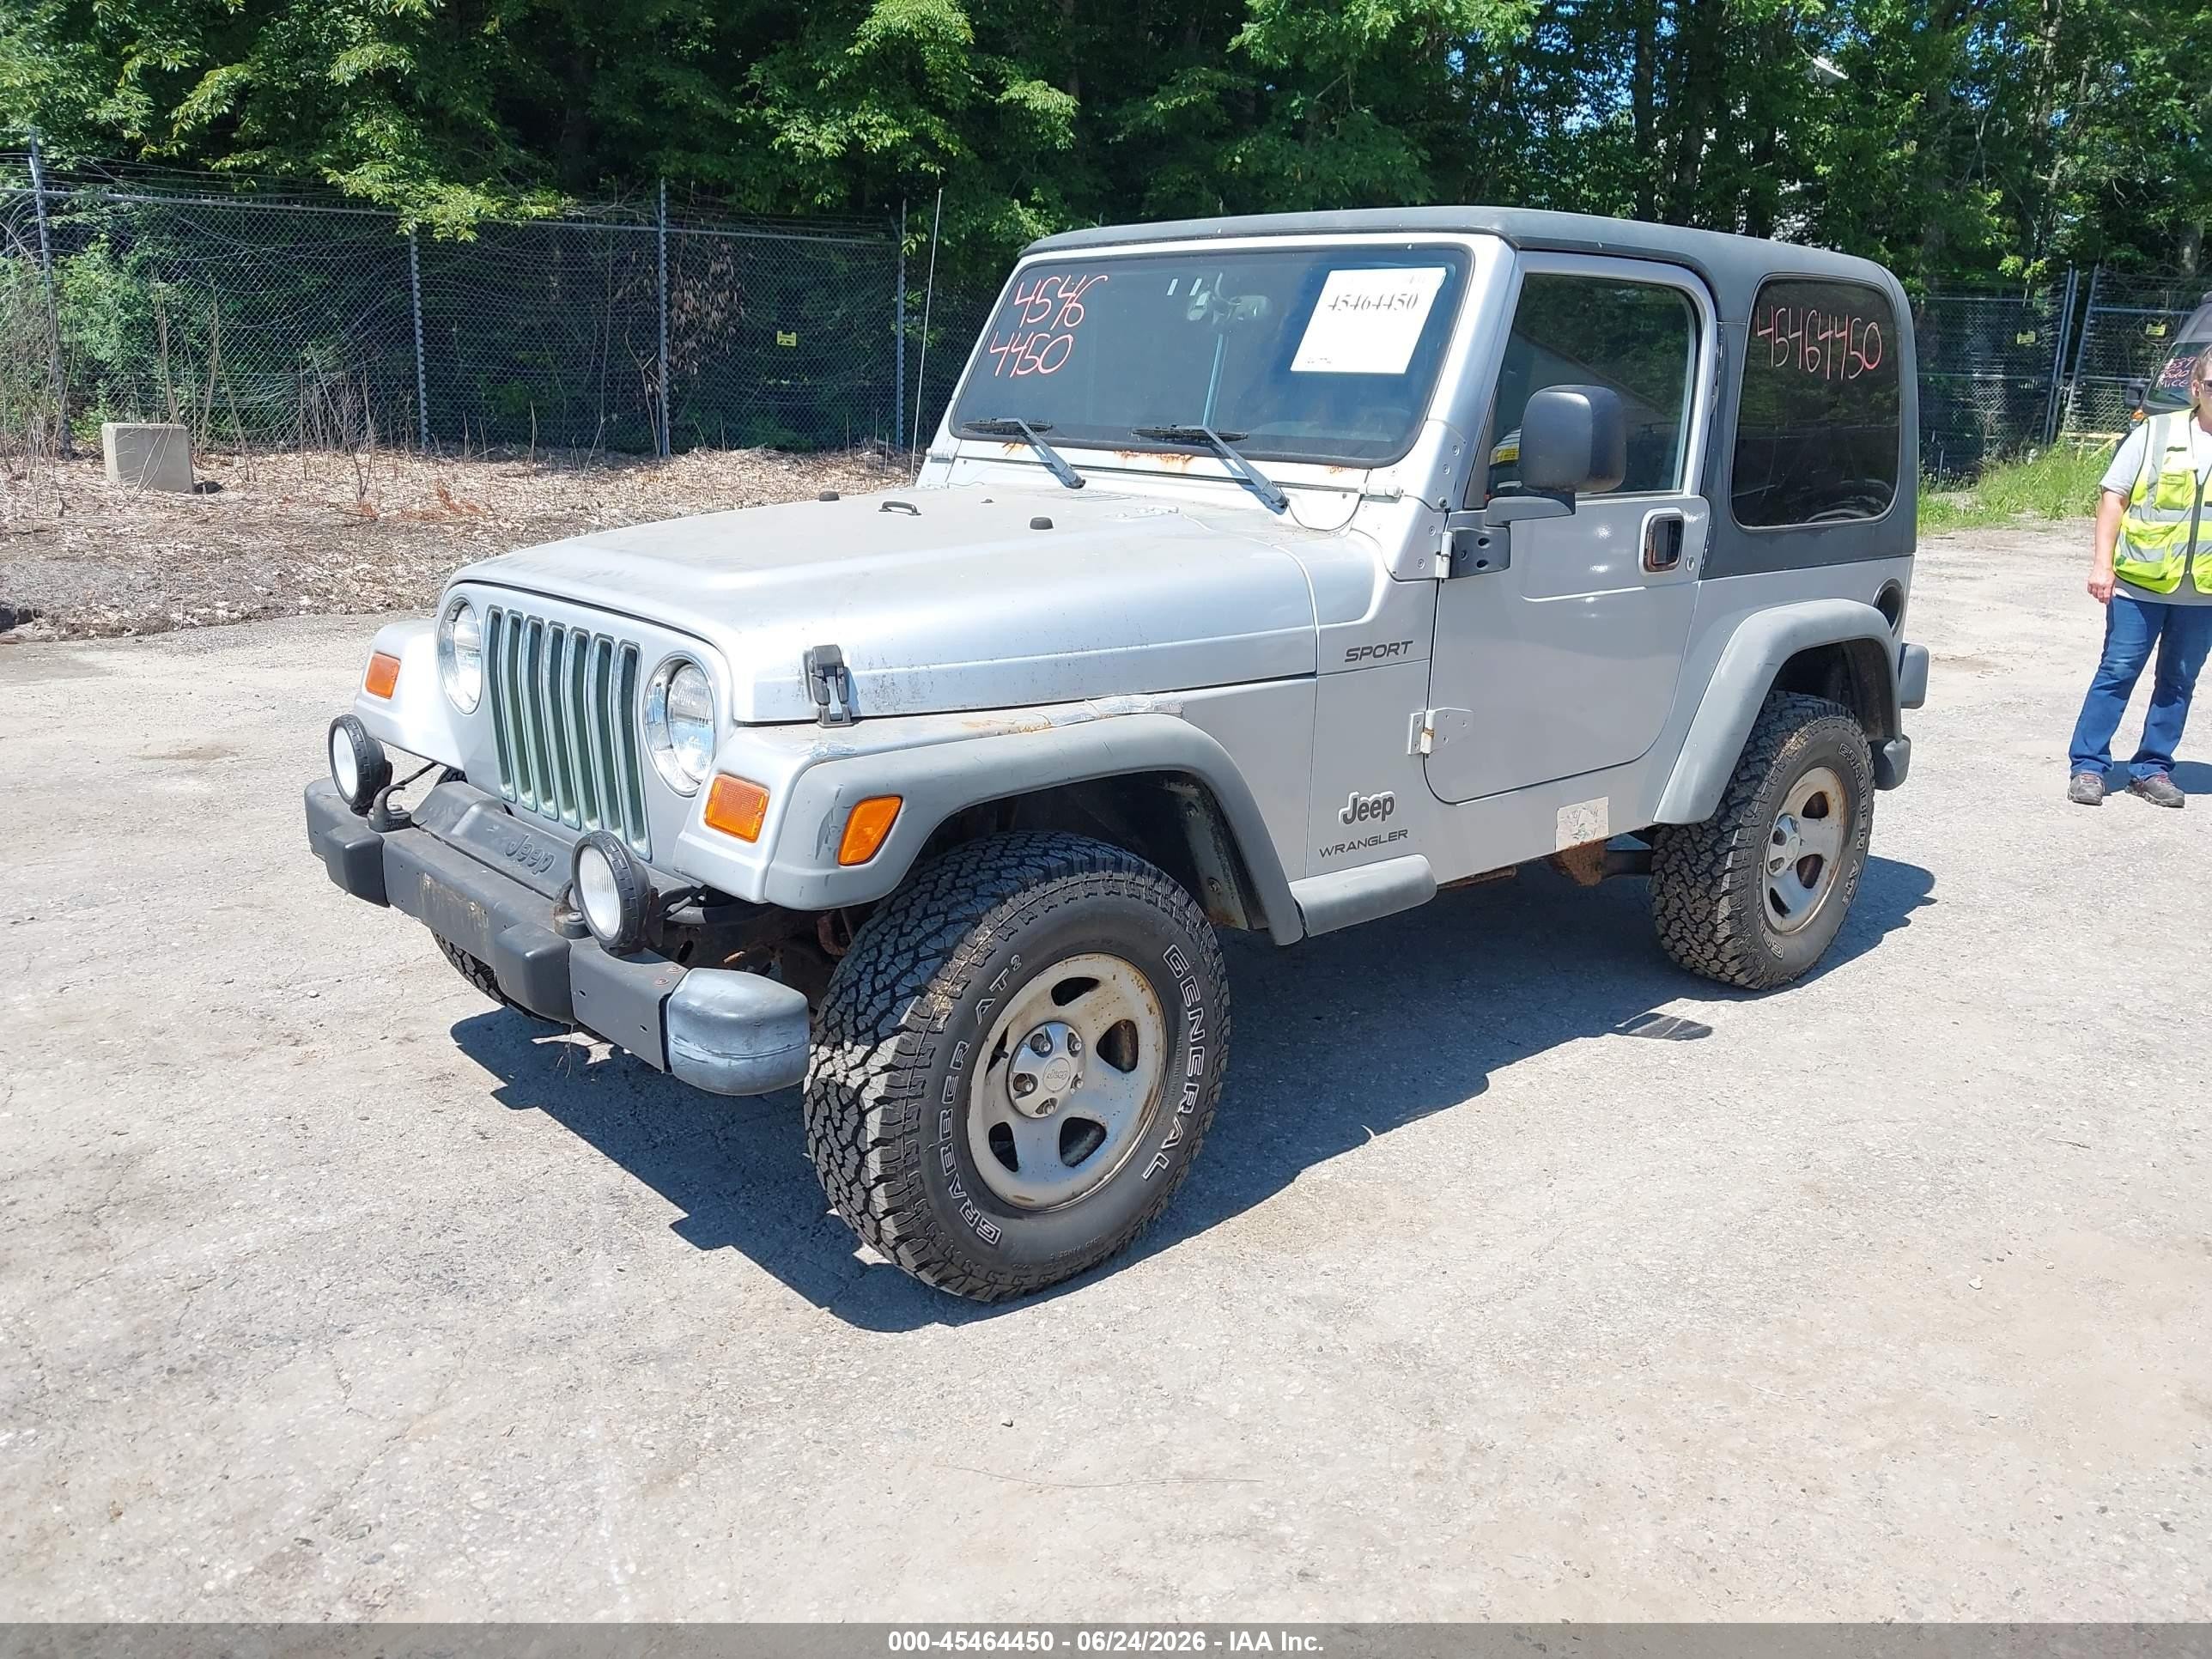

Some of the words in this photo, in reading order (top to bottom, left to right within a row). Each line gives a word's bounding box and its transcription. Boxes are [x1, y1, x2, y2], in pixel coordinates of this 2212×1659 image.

[1014, 274, 1109, 331] 4546
[989, 331, 1074, 378] 4450
[1757, 305, 1882, 380] 45464450
[1344, 640, 1413, 663] SPORT
[1339, 791, 1395, 826] Jeep
[503, 833, 556, 876] Jeep
[1319, 829, 1409, 858] WRANGLER
[1141, 944, 1206, 1182] GENERAL
[939, 1040, 1003, 1245] GRABBER
